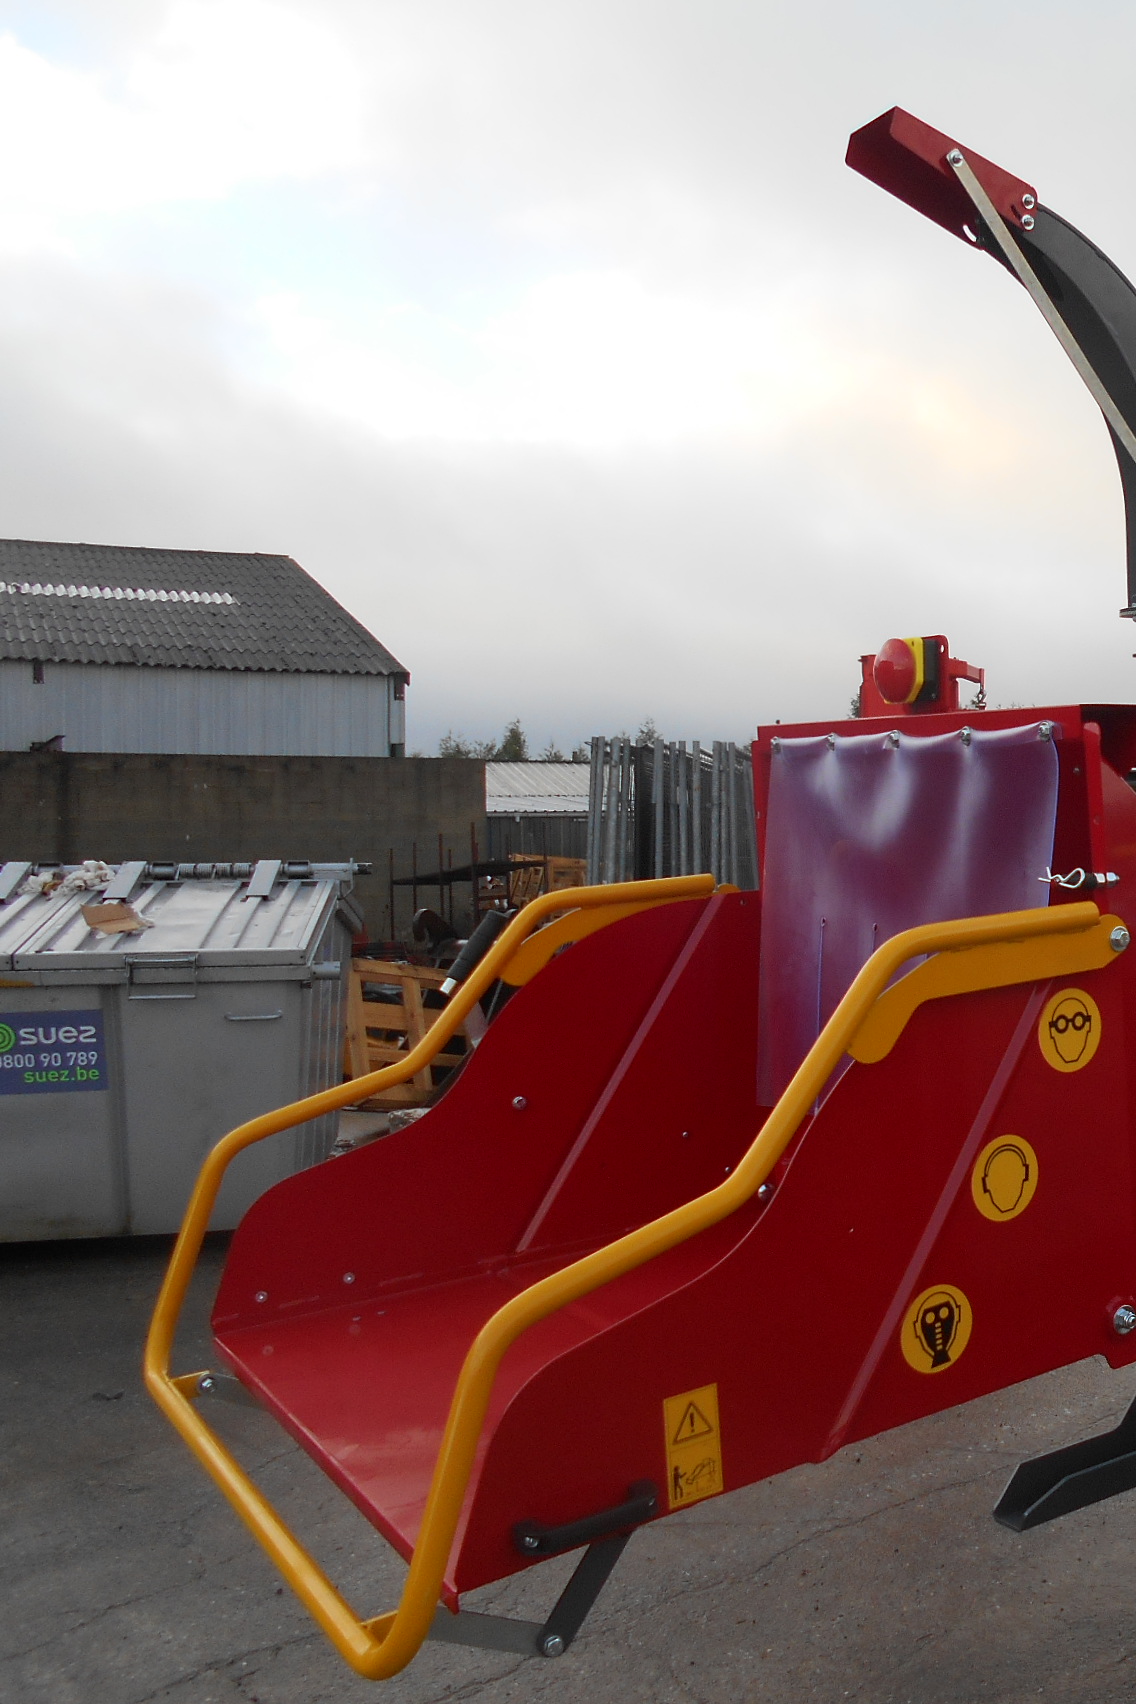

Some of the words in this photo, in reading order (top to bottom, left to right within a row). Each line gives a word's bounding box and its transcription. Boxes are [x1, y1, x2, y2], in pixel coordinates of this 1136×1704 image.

[19, 1025, 97, 1045] suez
[40, 1052, 62, 1067] 90
[66, 1051, 98, 1066] 789
[24, 1066, 100, 1083] suez.be
